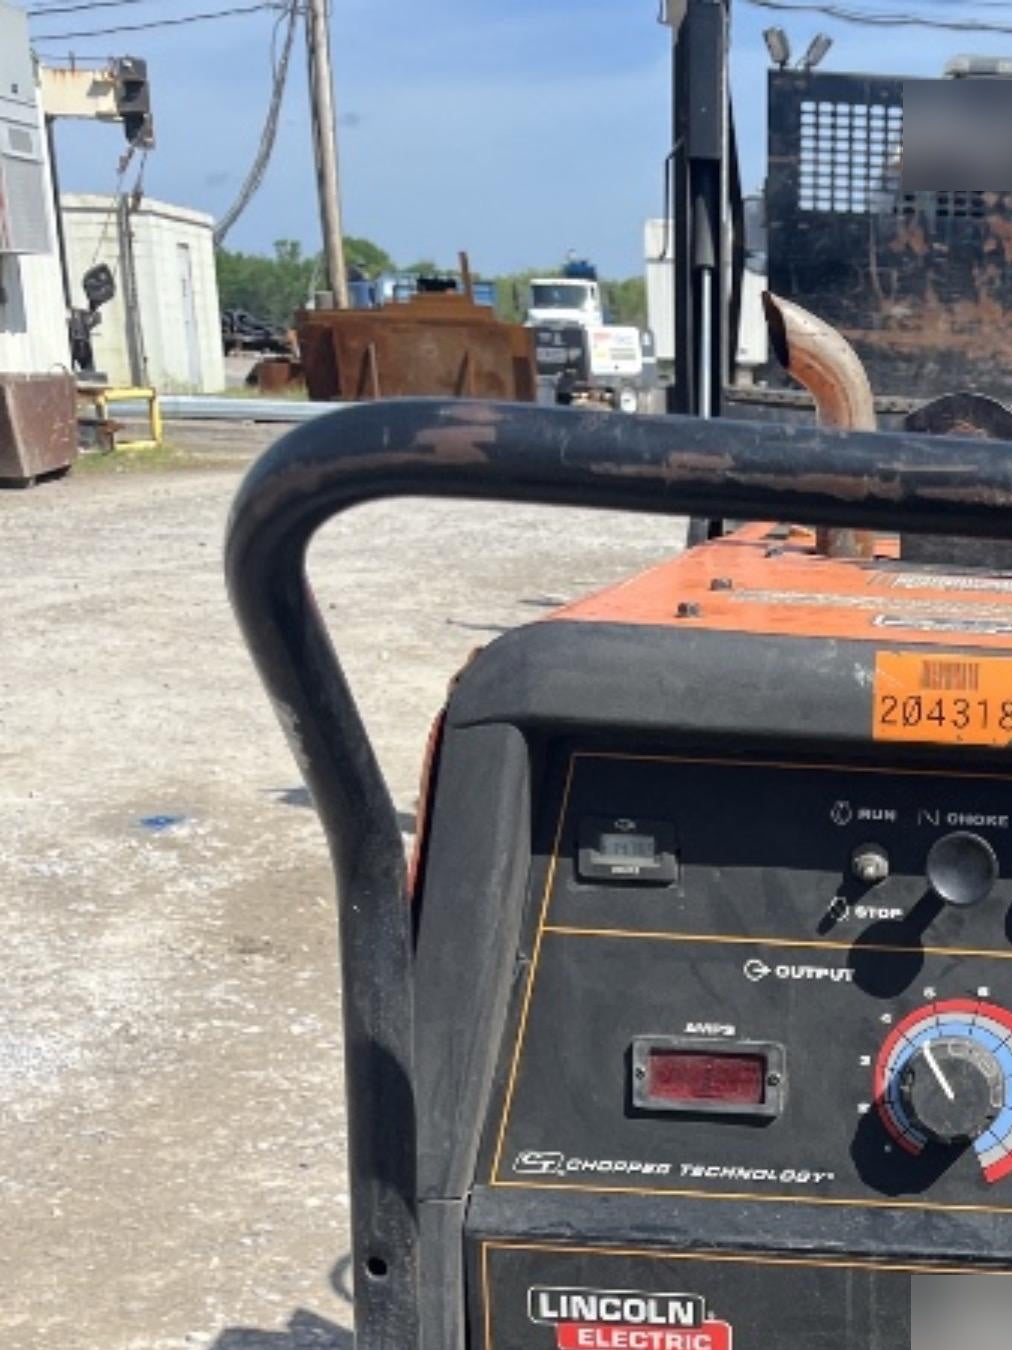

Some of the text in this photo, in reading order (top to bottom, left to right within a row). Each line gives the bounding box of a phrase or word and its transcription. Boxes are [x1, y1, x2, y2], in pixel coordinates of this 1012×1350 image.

[857, 808, 896, 821] RUN
[947, 812, 1009, 828] CHOKE
[853, 906, 903, 919] STOP
[775, 965, 855, 982] OUTPUT
[684, 1022, 736, 1036] AMPS
[566, 1158, 671, 1175] CHOPPER
[539, 1292, 694, 1326] LINCOLN
